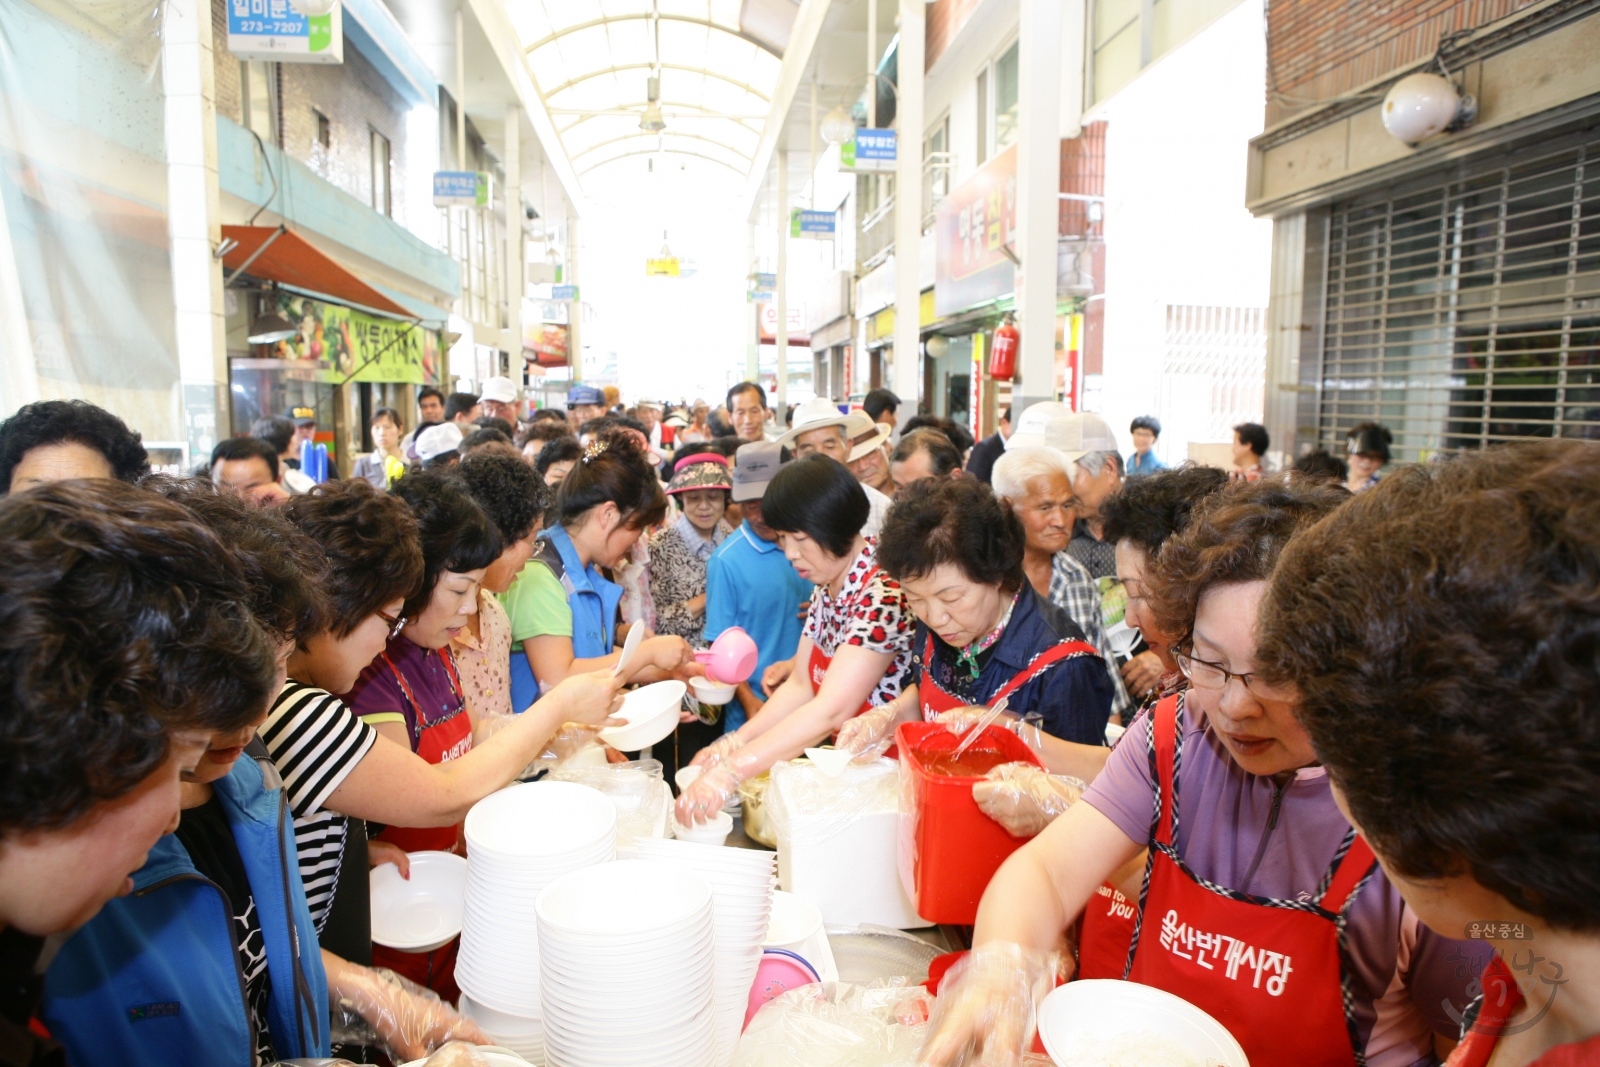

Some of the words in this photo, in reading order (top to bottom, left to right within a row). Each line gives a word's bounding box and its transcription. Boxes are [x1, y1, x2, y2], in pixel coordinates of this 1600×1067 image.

[232, 0, 306, 20] 일미분
[240, 20, 303, 34] 273-7207
[1107, 900, 1134, 919] you
[1159, 909, 1293, 997] 울산번개시장
